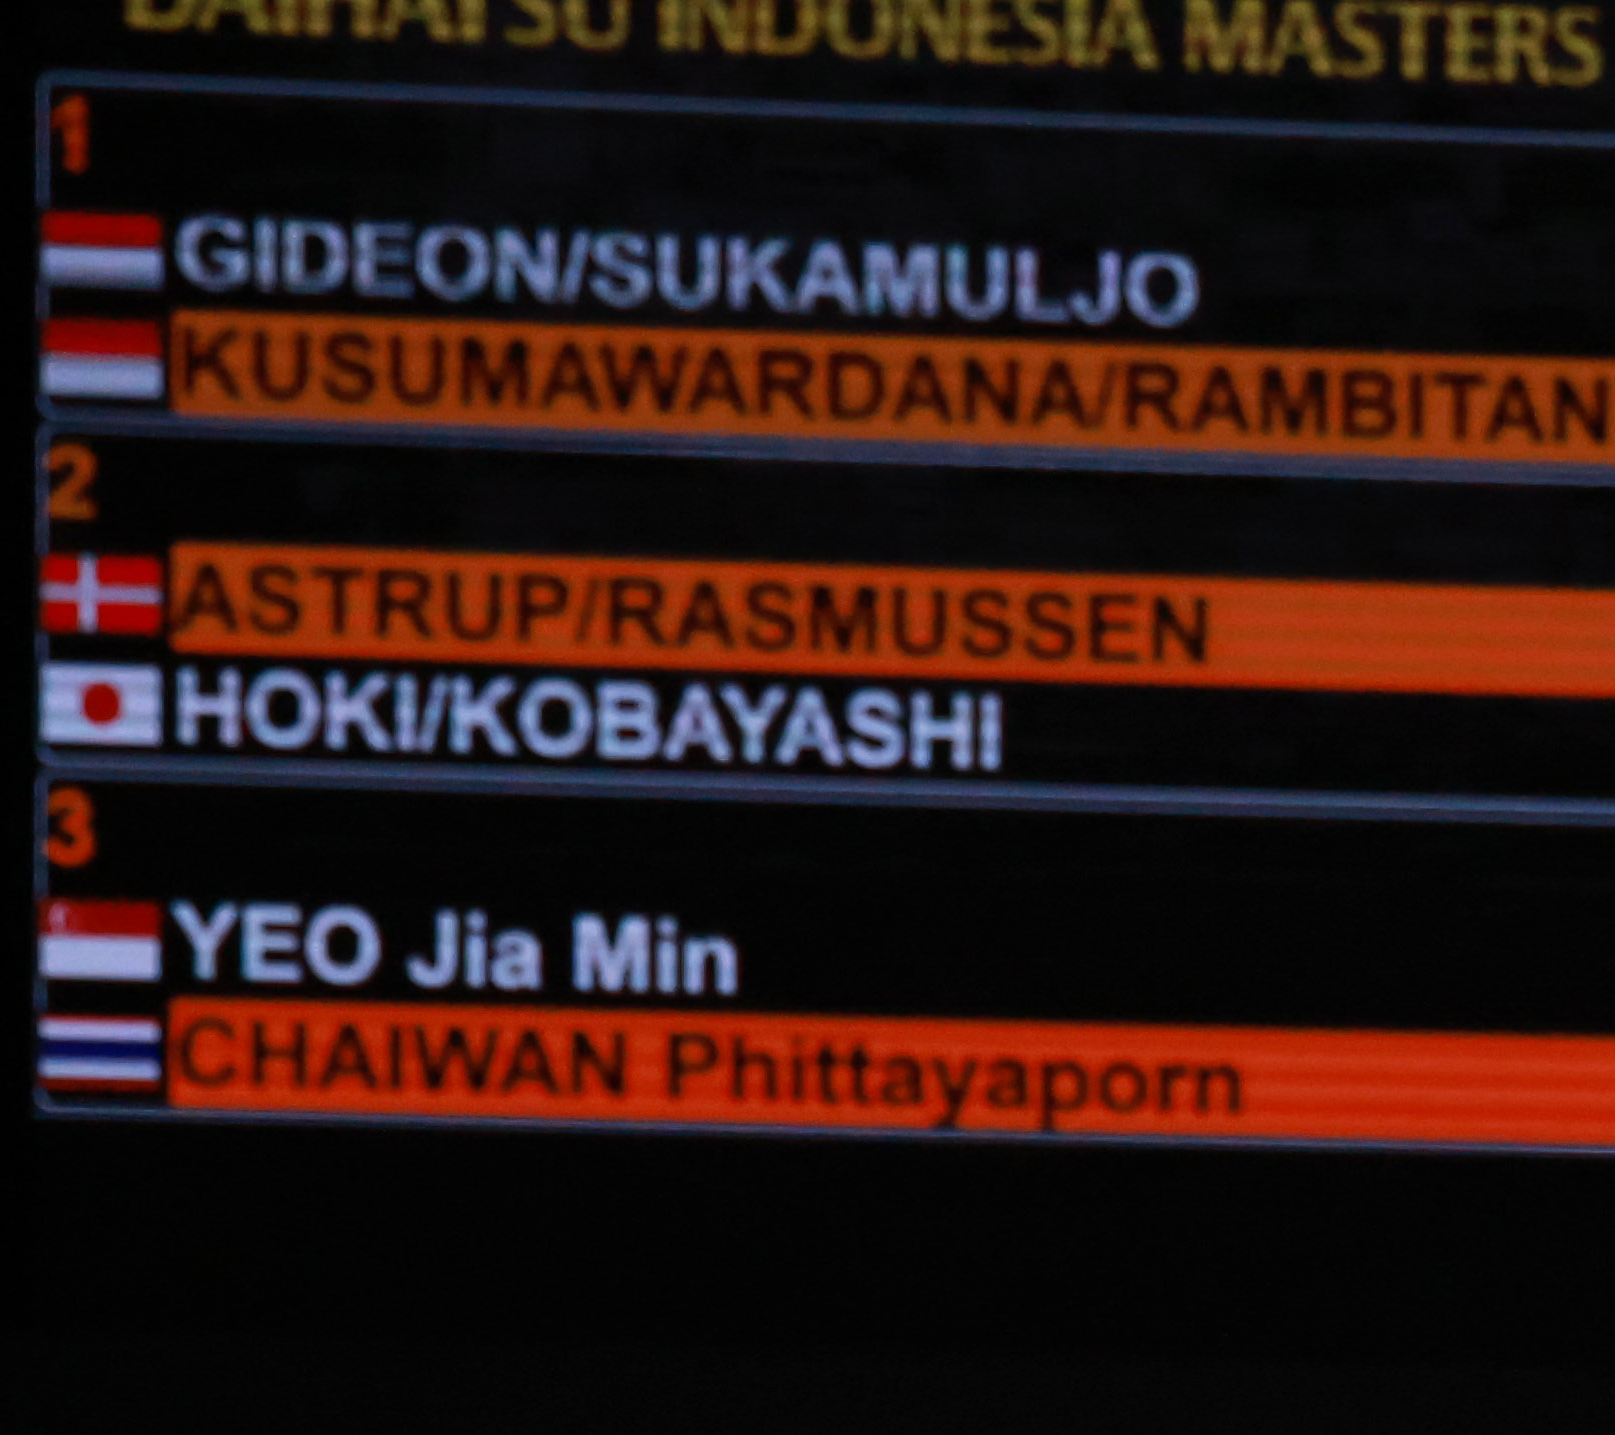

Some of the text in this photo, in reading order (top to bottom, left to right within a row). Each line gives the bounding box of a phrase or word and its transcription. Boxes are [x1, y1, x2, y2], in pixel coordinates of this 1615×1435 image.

[656, 0, 1160, 71] INDONESIA
[1182, 0, 1604, 87] MASTERS
[49, 94, 89, 174] 1
[175, 214, 1200, 328] GIDEON/SUKAMULJO
[183, 326, 1613, 446] KUSUMAWARDANA/RAMBITAN
[46, 445, 97, 520] 2
[175, 564, 1211, 666] ASTRUP/RASMUSSEN
[177, 669, 1002, 770] HOKI/KOBAYASHI
[45, 787, 96, 868] 3
[174, 904, 740, 995] YEO Jia Min
[179, 1016, 1245, 1133] CHAIWAN Phittayaporn
